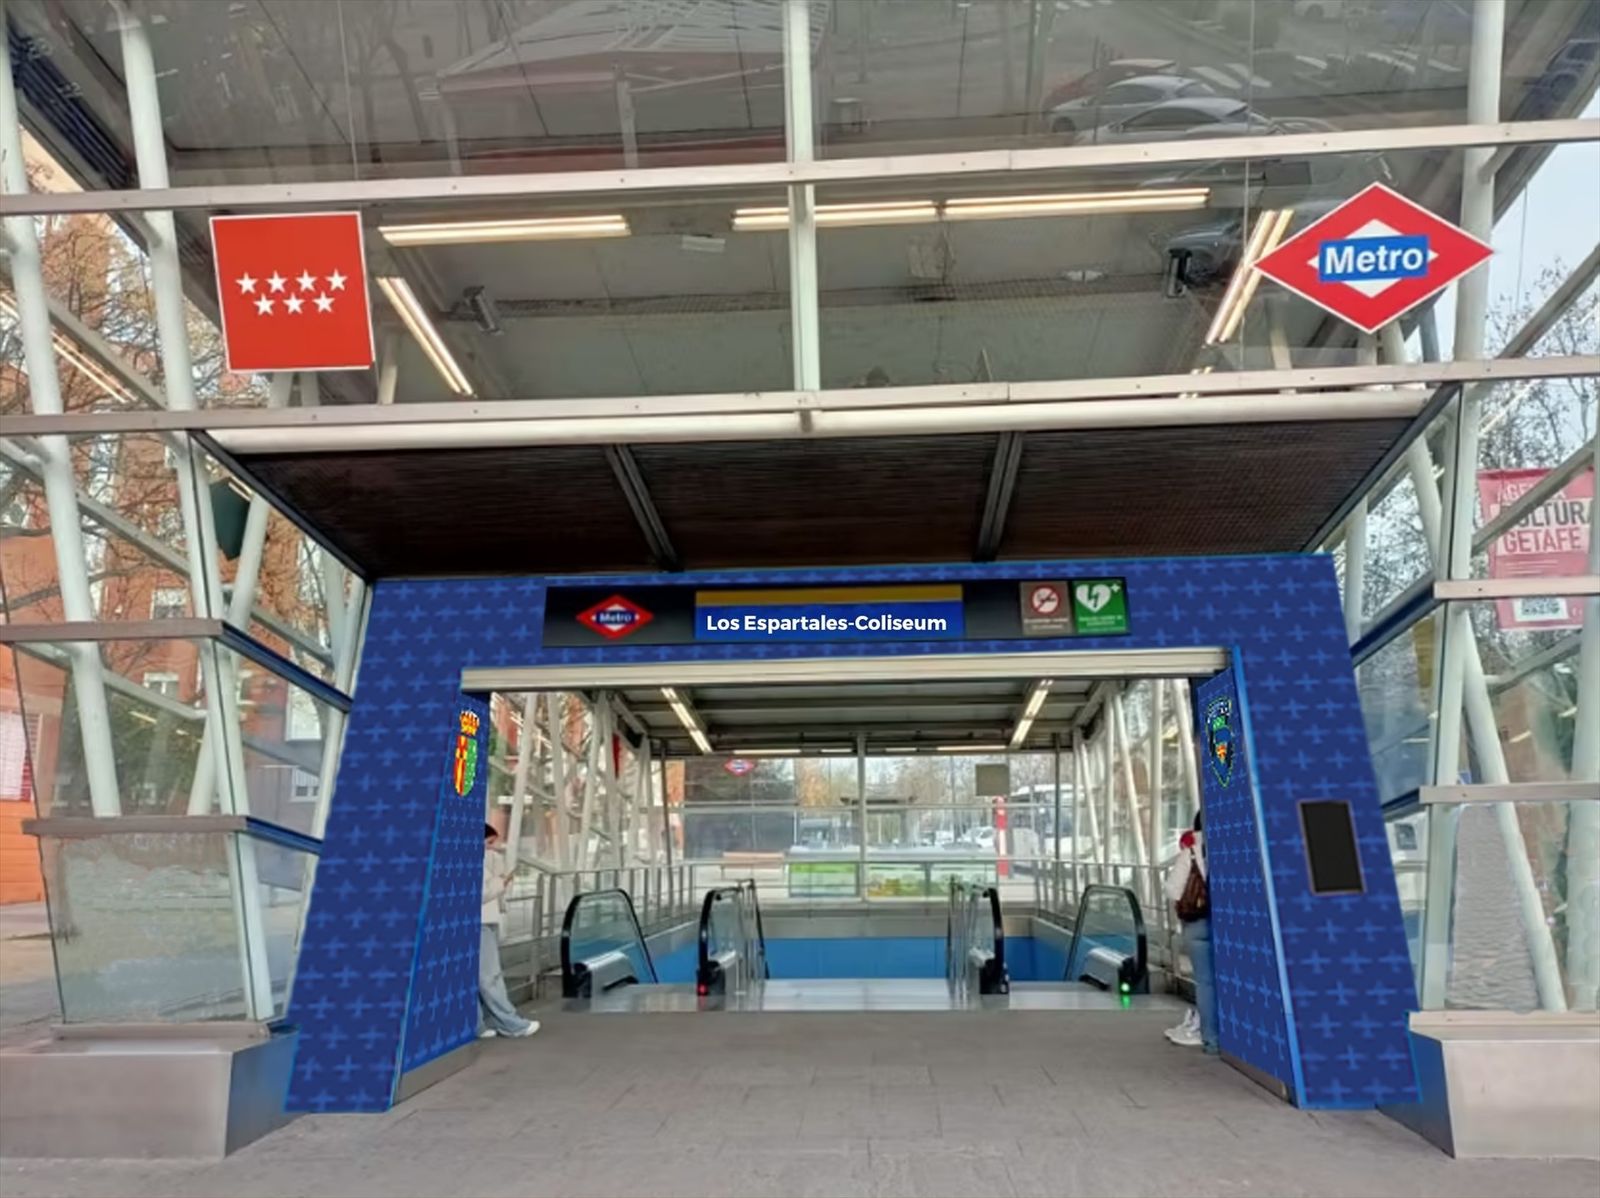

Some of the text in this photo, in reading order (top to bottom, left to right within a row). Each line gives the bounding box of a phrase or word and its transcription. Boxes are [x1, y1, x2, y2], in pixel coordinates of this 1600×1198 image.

[1325, 245, 1423, 274] Metro
[1503, 527, 1582, 553] GETAFE
[599, 611, 632, 622] Metro
[706, 614, 947, 634] Los Espartales-Coliseum
